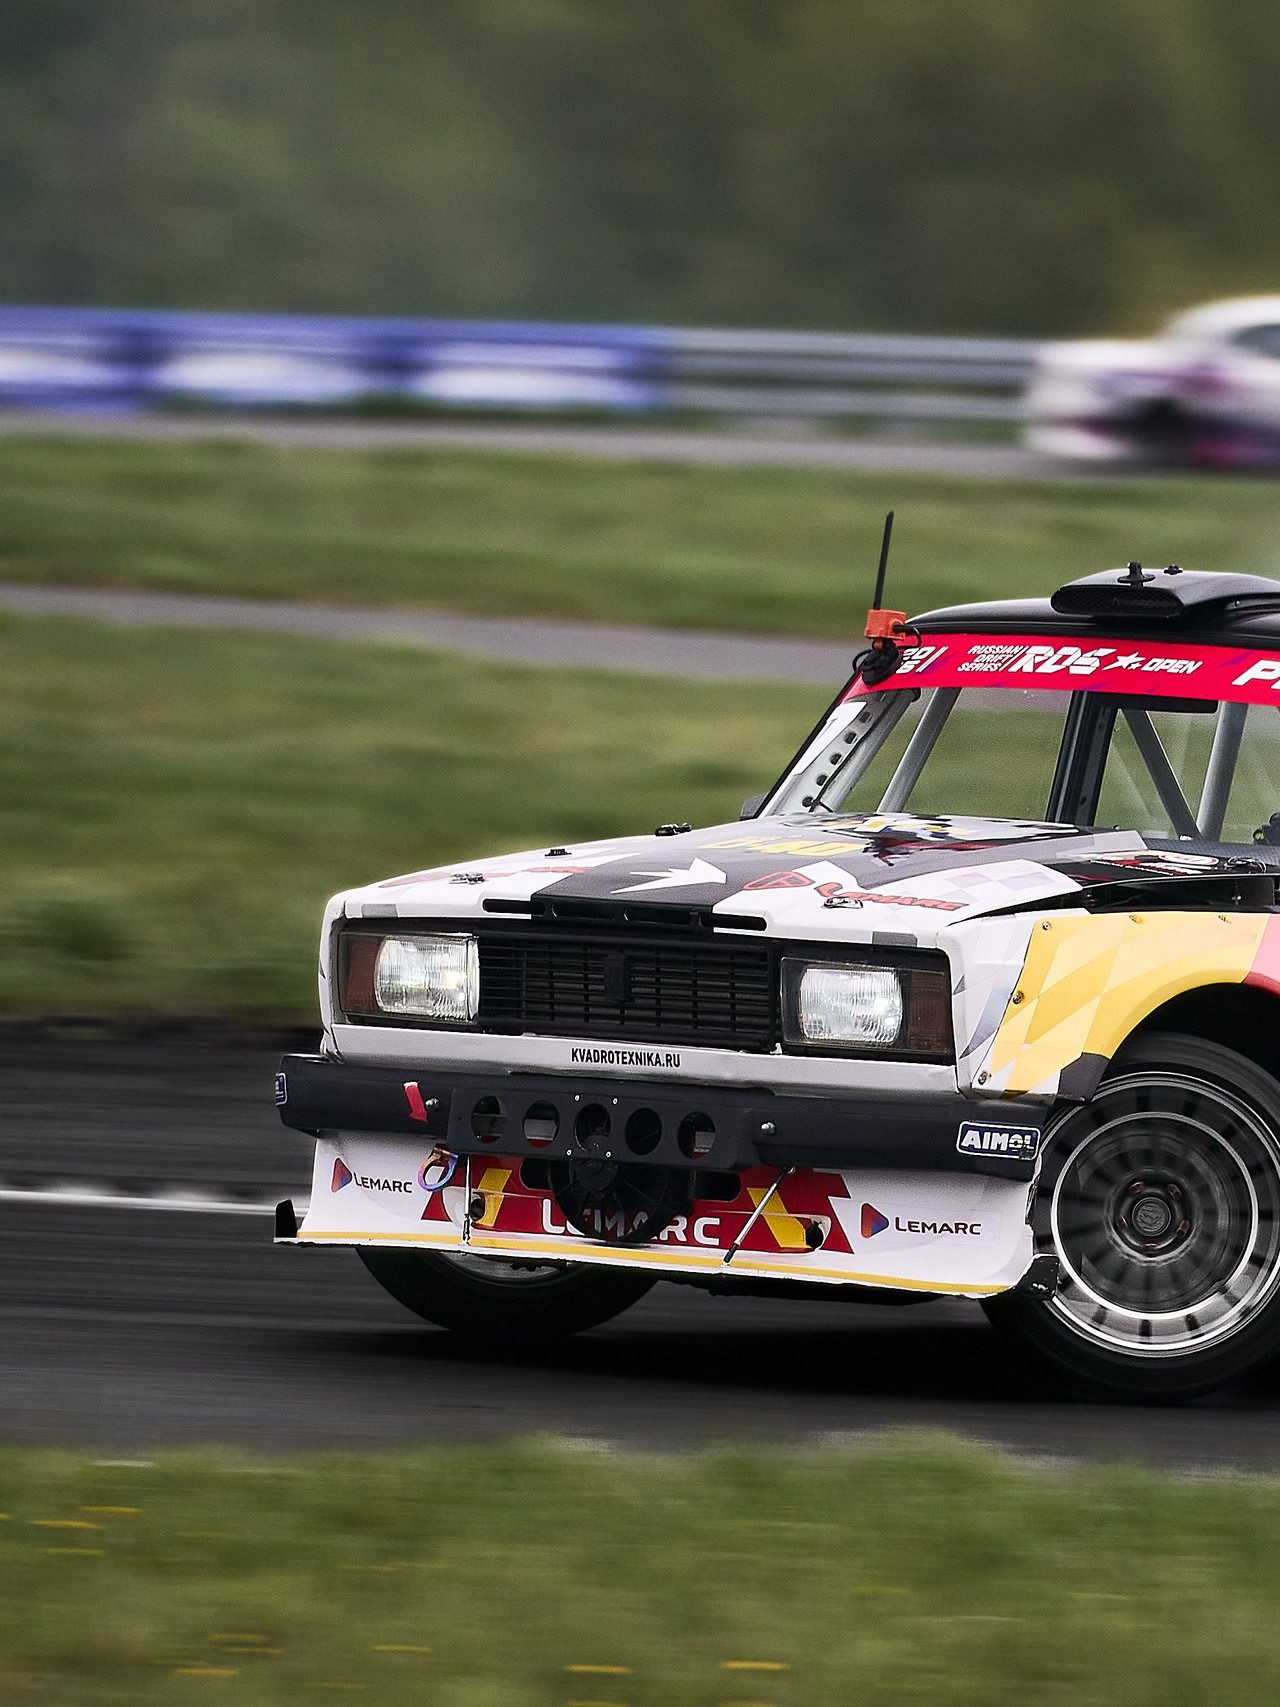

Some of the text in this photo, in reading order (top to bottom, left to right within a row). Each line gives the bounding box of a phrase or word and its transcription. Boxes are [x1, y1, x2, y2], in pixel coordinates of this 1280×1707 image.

[967, 645, 1023, 655] RUSSIAN
[973, 654, 1013, 663] DRIFT
[957, 662, 1002, 672] SERIES
[1007, 645, 1203, 675] RDS OPEN
[571, 1047, 681, 1067] KVADROTEXNIKA.RU
[960, 1130, 1035, 1152] AIMOL
[353, 1171, 414, 1194] LEMARC
[895, 1216, 982, 1235] LEMARC
